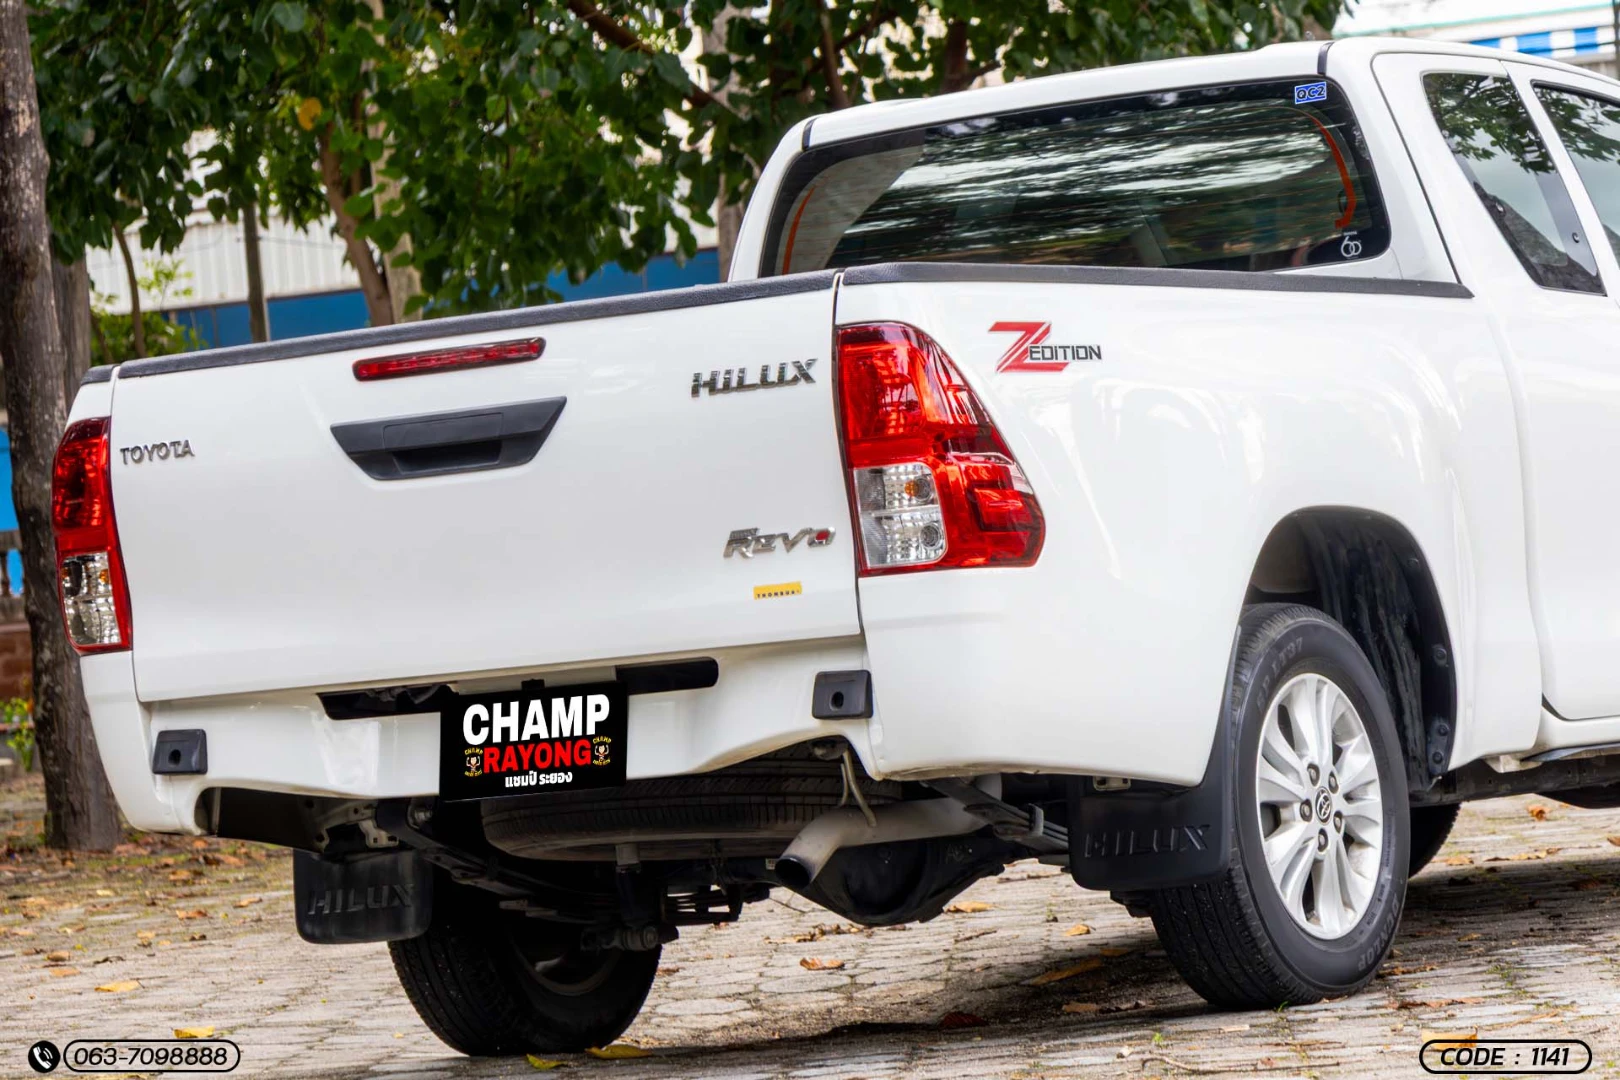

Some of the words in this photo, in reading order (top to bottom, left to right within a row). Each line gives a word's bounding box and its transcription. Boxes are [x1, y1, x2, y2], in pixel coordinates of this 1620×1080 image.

[1296, 85, 1326, 100] QC2
[988, 321, 1069, 373] Z
[1029, 345, 1102, 360] EDITION
[119, 439, 195, 466] TOYOTA
[1085, 823, 1211, 858] HILUX
[308, 882, 415, 915] HILUX
